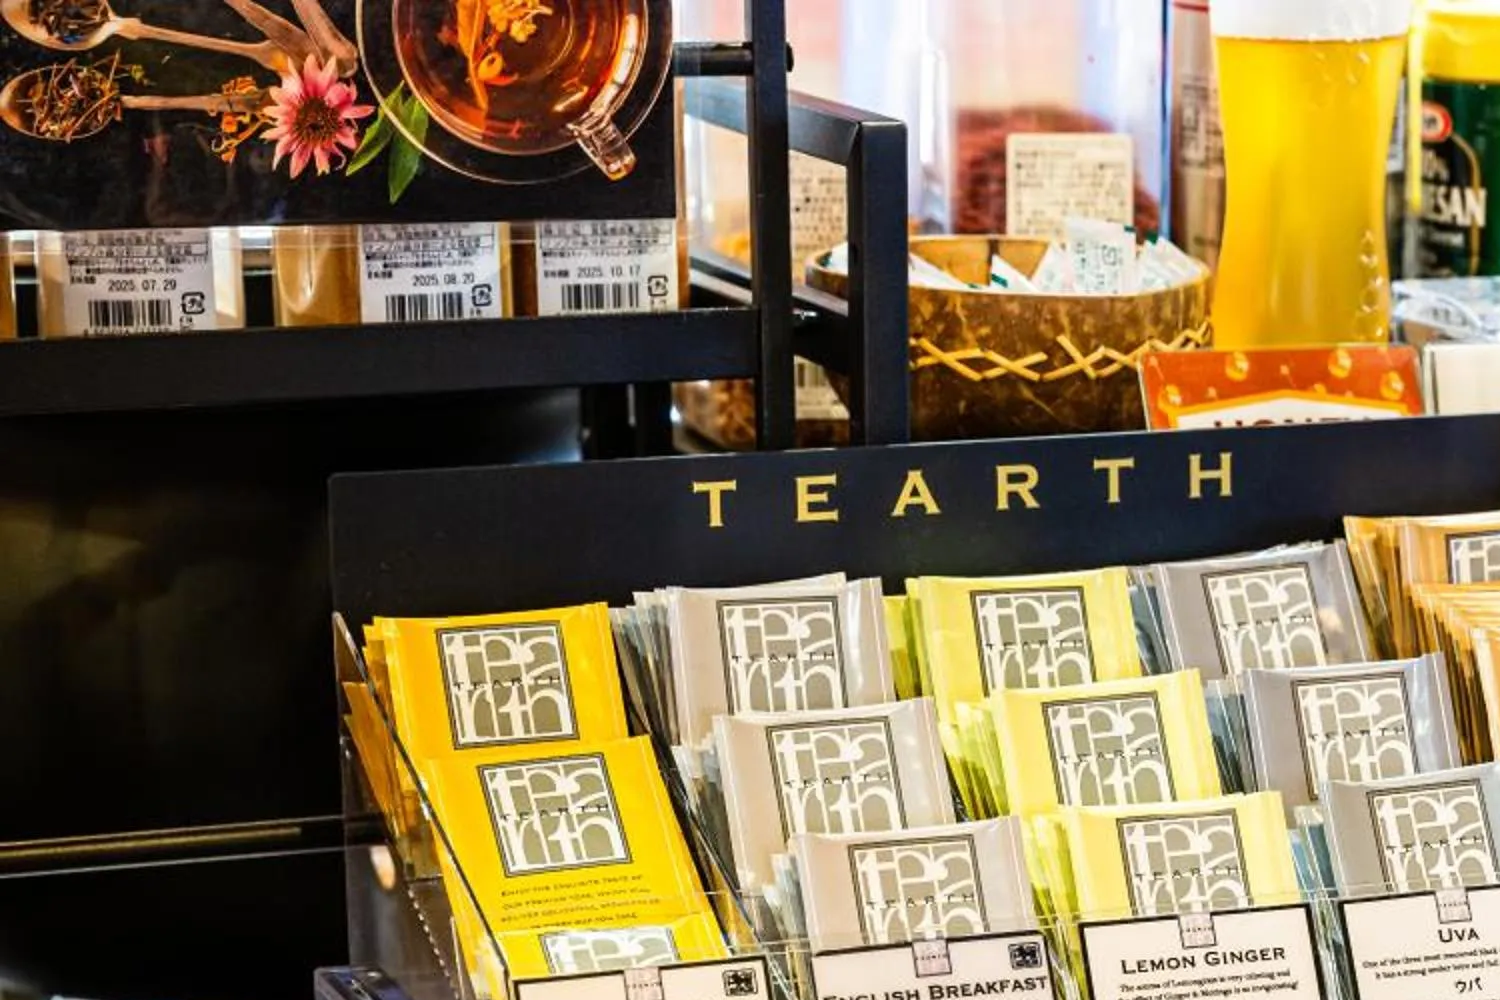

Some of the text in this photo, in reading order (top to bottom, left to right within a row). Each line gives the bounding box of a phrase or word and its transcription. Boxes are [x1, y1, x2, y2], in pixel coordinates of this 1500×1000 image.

[692, 452, 1233, 527] TEARTH
[1437, 924, 1480, 944] UVA
[1120, 944, 1287, 975] LEMON GINGER
[927, 973, 1048, 1000] BREAKFAST
